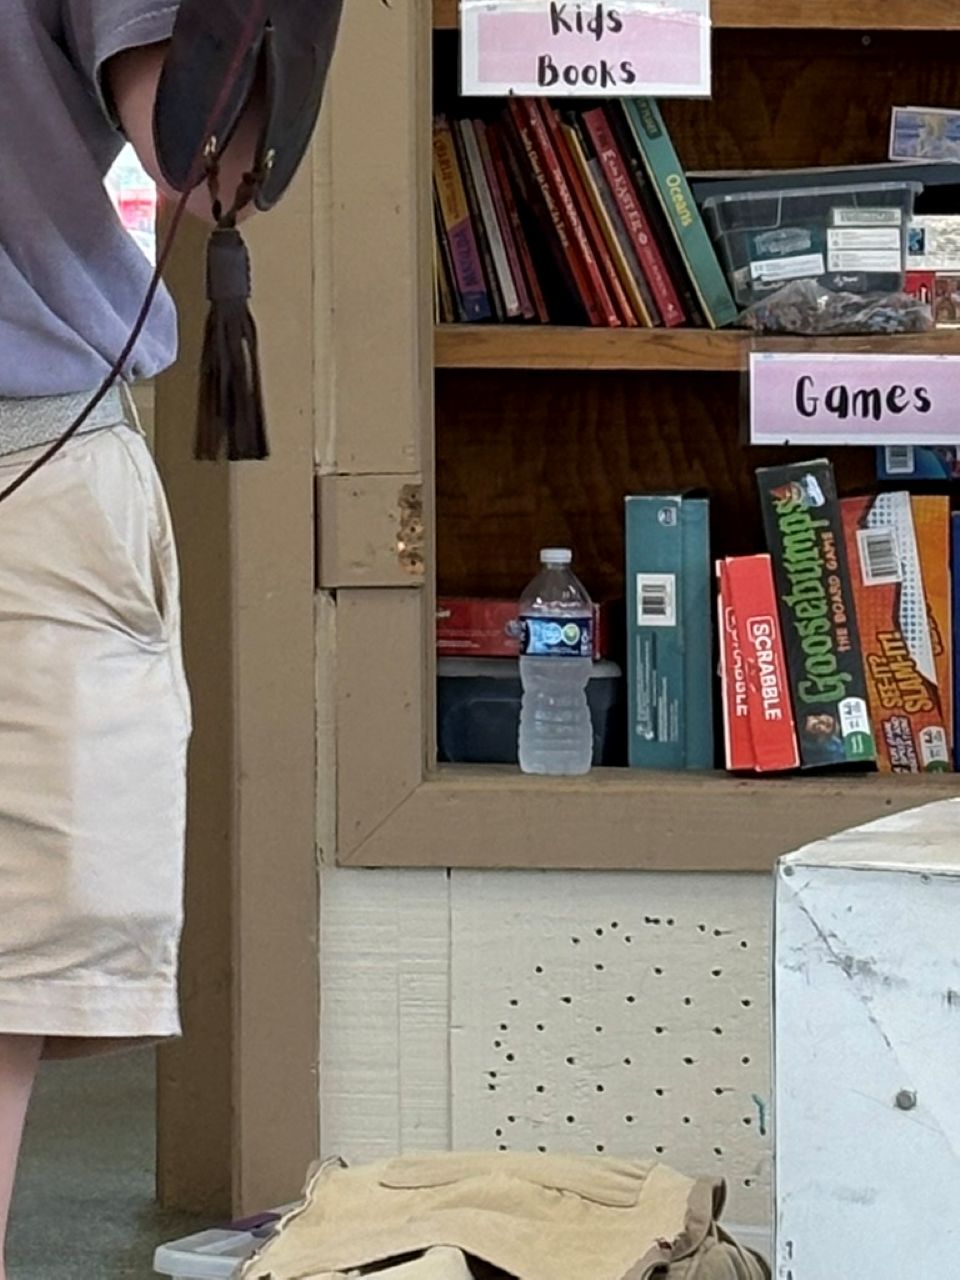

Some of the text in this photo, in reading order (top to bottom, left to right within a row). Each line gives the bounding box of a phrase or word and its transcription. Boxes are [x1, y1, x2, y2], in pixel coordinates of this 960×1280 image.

[550, 1, 623, 41] Kids
[537, 55, 637, 88] Books
[661, 172, 698, 227] Oceans
[796, 375, 931, 421] Games
[771, 493, 850, 703] Goosebumps
[822, 531, 850, 653] THE BOARD GAME
[749, 622, 785, 722] SCRABBLE
[868, 655, 902, 711] SEE-IT?
[876, 631, 933, 714] SLAM-IT!
